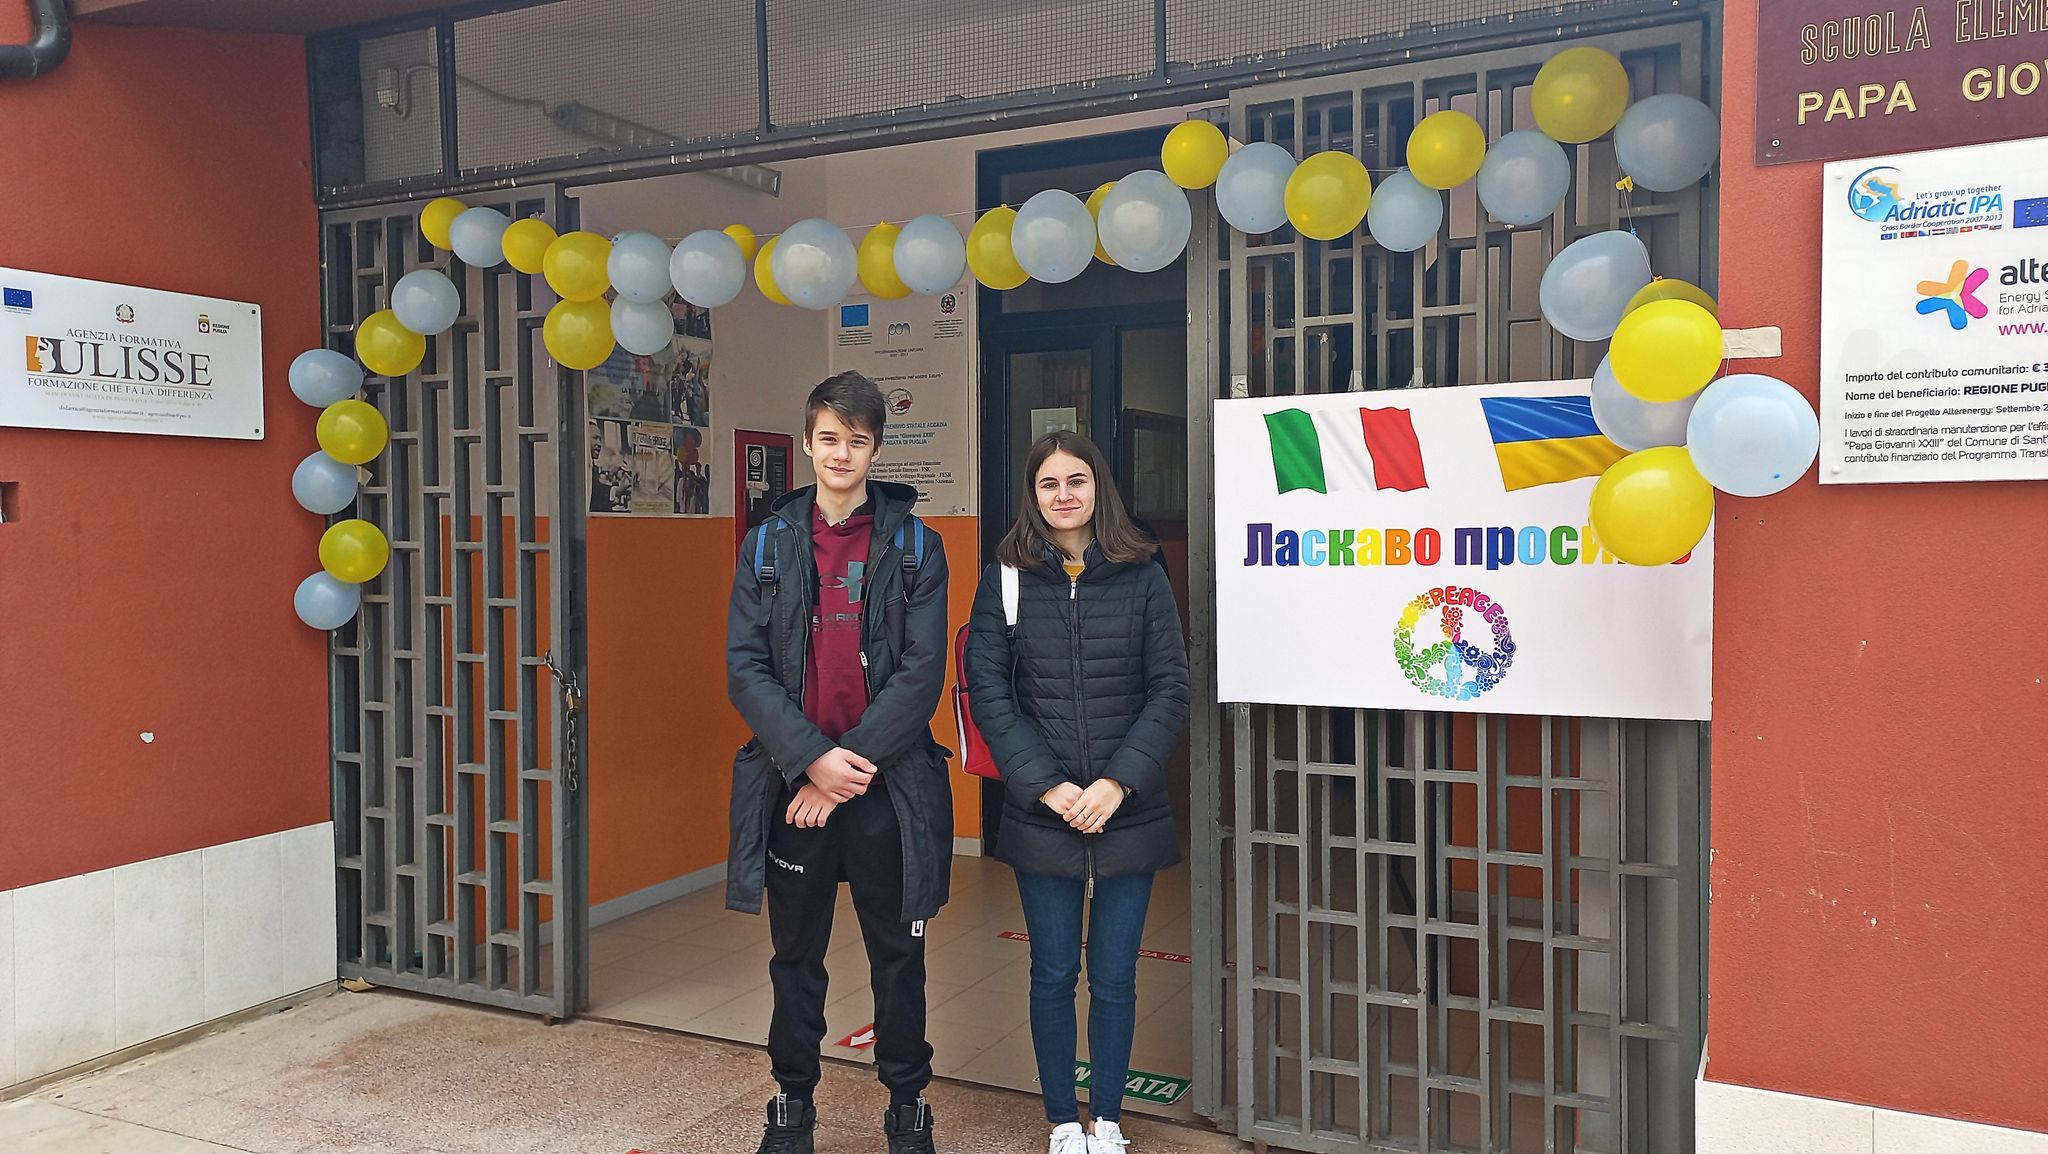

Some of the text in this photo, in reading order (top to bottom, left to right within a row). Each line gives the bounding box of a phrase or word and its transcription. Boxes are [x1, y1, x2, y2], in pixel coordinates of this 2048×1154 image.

[1801, 6, 1931, 66] SCUOLA
[1797, 59, 2048, 126] PAPA GIO
[1916, 185, 2002, 200] Let's grow up together
[1883, 193, 2003, 222] Adriatic IPA
[1881, 213, 2003, 232] Cross Border Cooperation 2007-2013
[1999, 293, 2041, 304] Energy
[1999, 305, 2015, 316] for
[66, 328, 182, 349] AGENZIA FORMATIVA
[42, 337, 214, 387] ULISSE
[1845, 372, 1884, 384] Importo
[1886, 371, 1903, 381] del
[1905, 368, 1959, 380] contributo
[1961, 364, 2029, 377] comunitario:
[2032, 363, 2041, 373] €
[28, 377, 213, 400] FORMAZIONE CHE FA LA DIFFERENZA
[1845, 382, 2048, 401] Nome del beneficiario: REGIONE PUG
[1845, 411, 1866, 420] Inizio
[1874, 410, 1889, 419] fine
[1891, 409, 1904, 418] del
[1905, 408, 1940, 419] Progetto
[1942, 405, 1994, 416] Alterenergy:
[1996, 404, 2041, 414] Settembre
[1849, 428, 1873, 438] lavori
[1874, 427, 1883, 437] di
[1884, 425, 1939, 437] straordinaria
[1941, 423, 2008, 435] manutenzione
[2010, 424, 2026, 434] per
[1844, 440, 1873, 451] "Papa
[1874, 439, 1916, 450] Giovanni
[1917, 438, 1945, 448] XXIII"
[1947, 437, 1962, 447] del
[1964, 436, 2008, 447] Comune
[2010, 435, 2020, 446] di
[1844, 448, 2048, 464] contributo finanziario del Programma Trans
[1243, 522, 1692, 570] Ласкаво проси
[1429, 585, 1505, 624] PEACE
